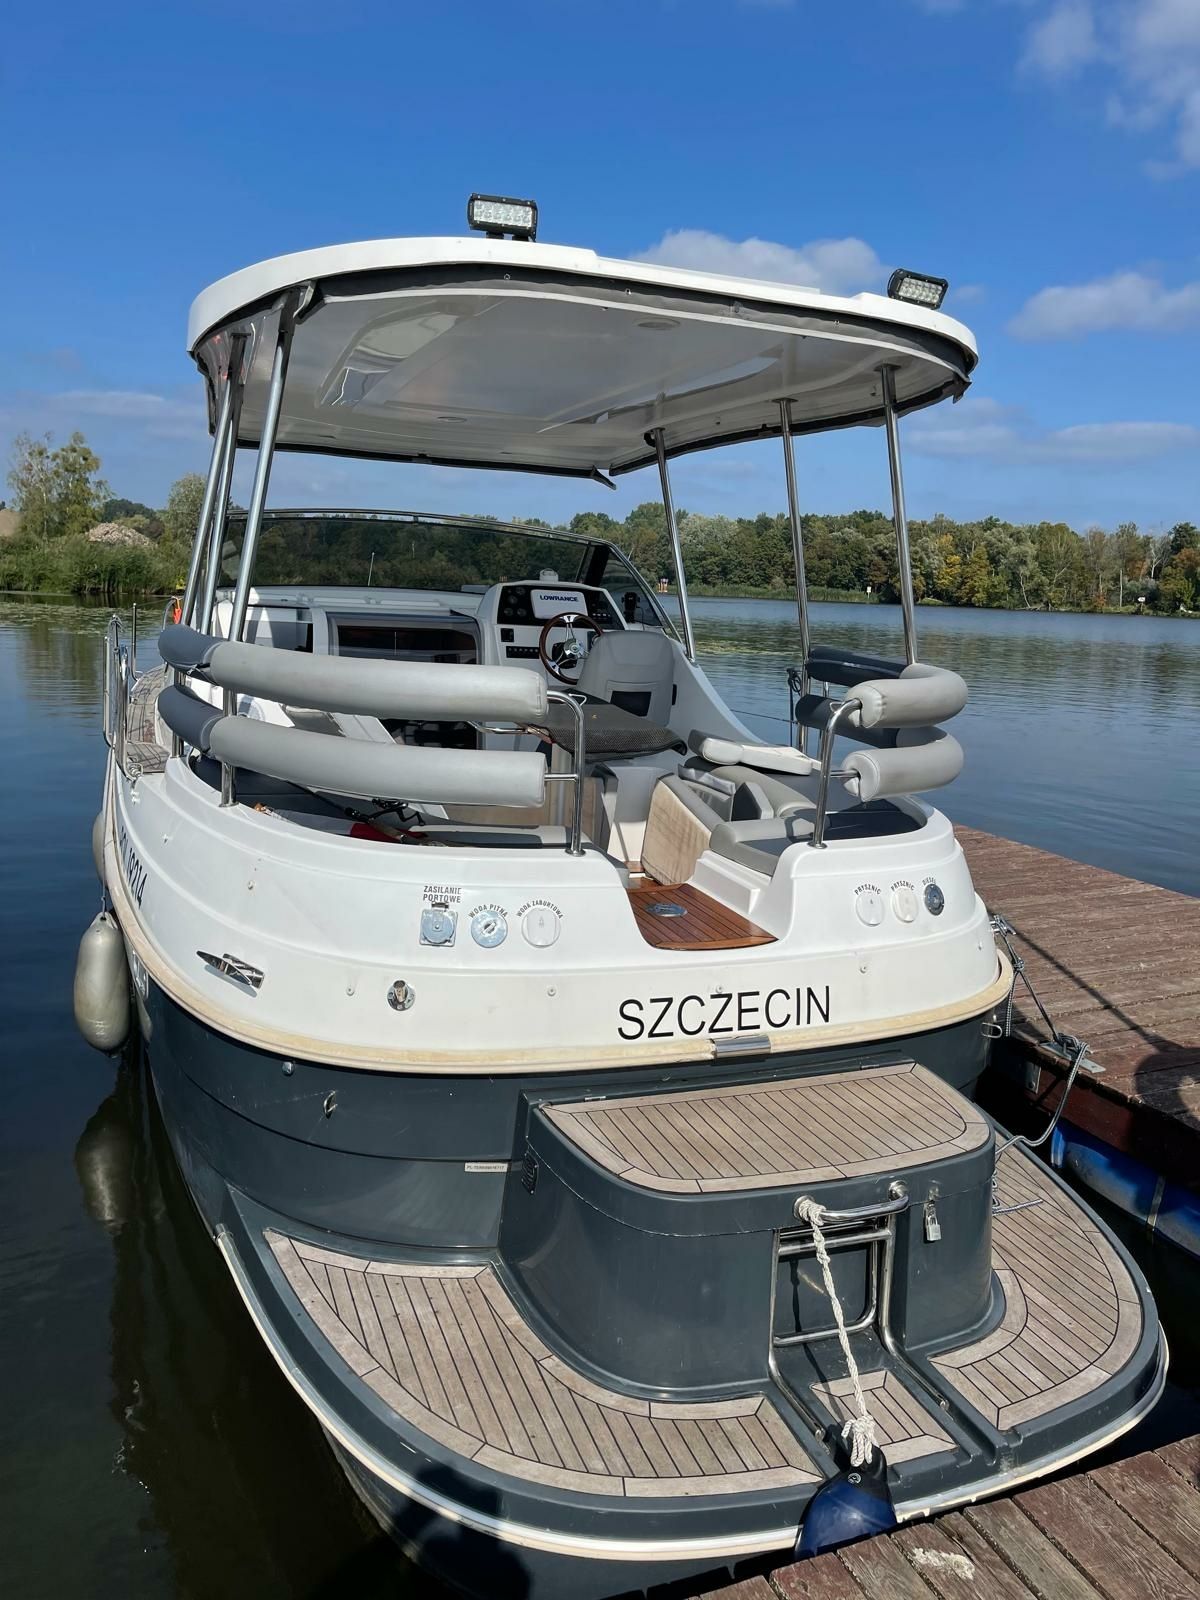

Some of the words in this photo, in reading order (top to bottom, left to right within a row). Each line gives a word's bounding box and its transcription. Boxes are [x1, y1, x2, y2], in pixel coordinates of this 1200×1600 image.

[854, 884, 882, 896] PRYSZNIC
[891, 880, 915, 892] PRYSZNIC
[423, 894, 462, 904] PORTOWE
[468, 904, 488, 919] WODA
[489, 903, 509, 918] PITNA
[516, 904, 532, 918] WODA
[617, 985, 830, 1041] SZCZECIN
